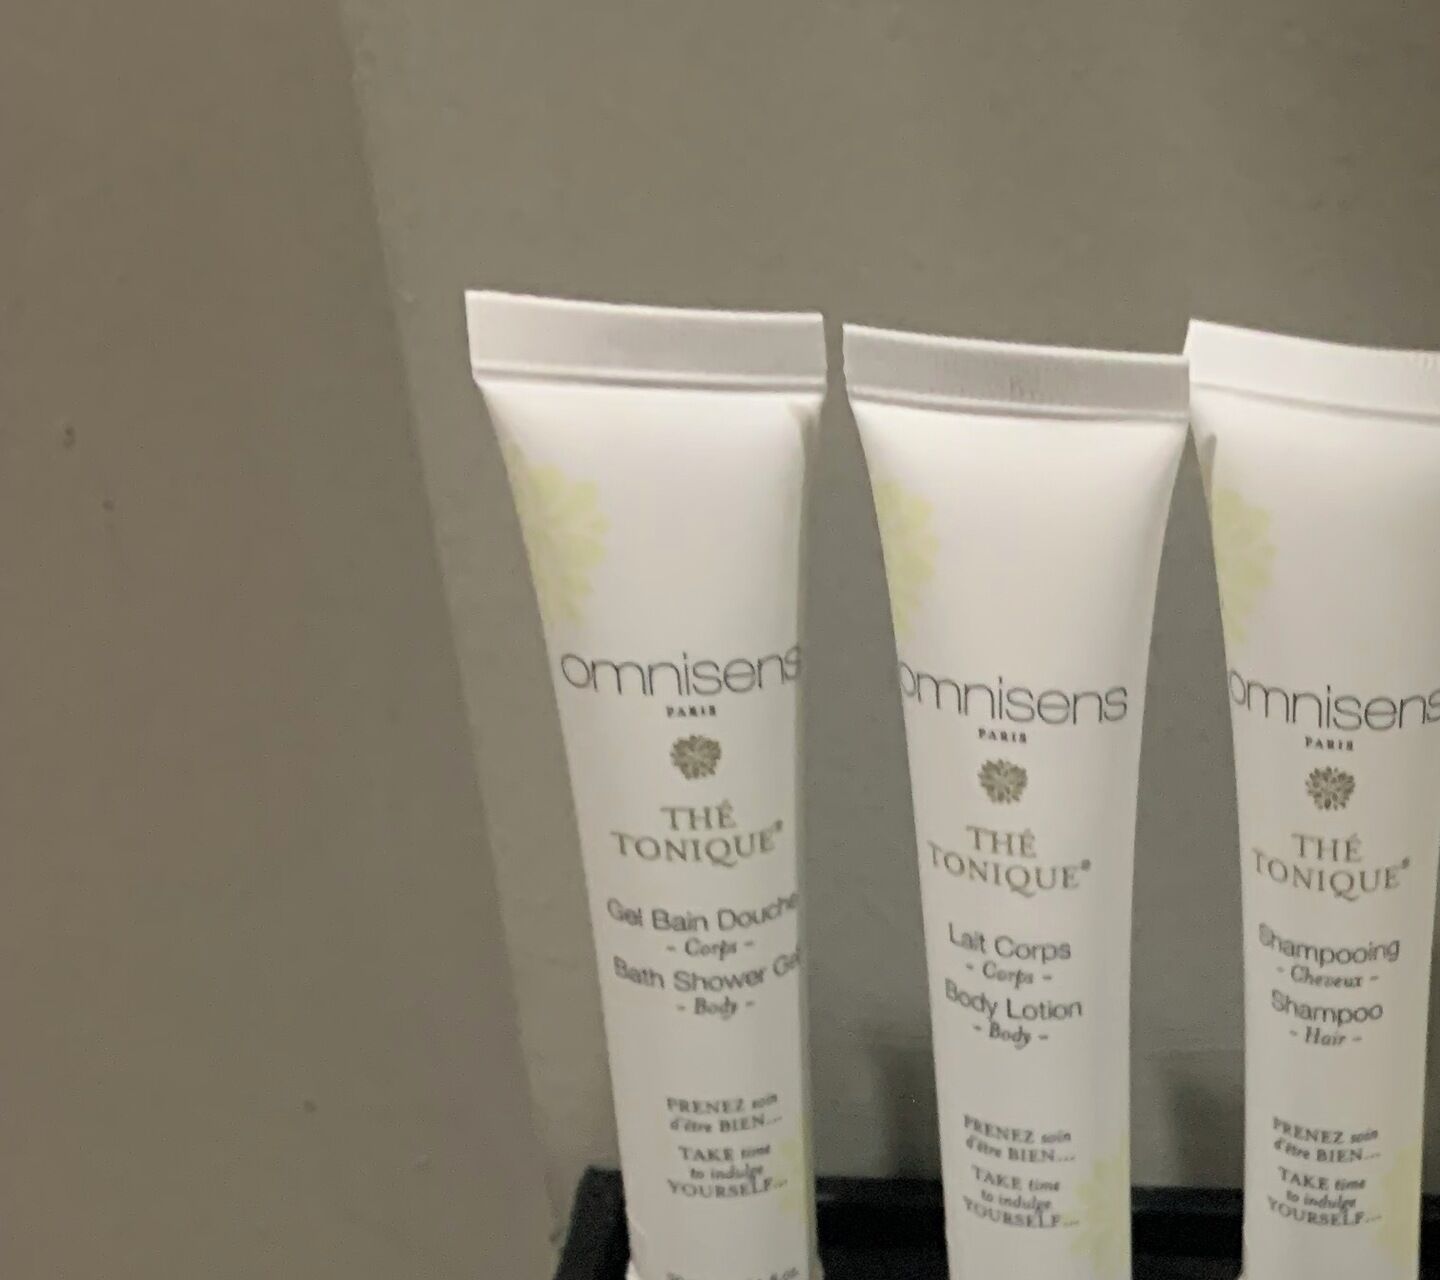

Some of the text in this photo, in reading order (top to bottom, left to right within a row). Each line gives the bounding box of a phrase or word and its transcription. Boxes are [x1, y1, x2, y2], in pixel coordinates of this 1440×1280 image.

[561, 645, 801, 697] omnisens
[900, 661, 1128, 725] omnisens
[665, 704, 717, 718] PARIS
[978, 728, 1027, 743] PARIS
[1305, 736, 1354, 751] PARIS
[652, 907, 709, 932] Bain
[948, 921, 1071, 965] Lait Corps
[1258, 922, 1401, 968] Shampooing
[613, 954, 666, 989] Bath
[673, 967, 767, 992] Shower
[945, 977, 1082, 1022] Body Lotion
[1271, 989, 1384, 1028] Shampoo
[963, 1114, 1035, 1145] PRENEZ
[1273, 1116, 1345, 1145] PRENEZ
[678, 1145, 735, 1162] TAKE
[971, 1164, 1023, 1191] TAKE
[1278, 1166, 1329, 1191] TAKE
